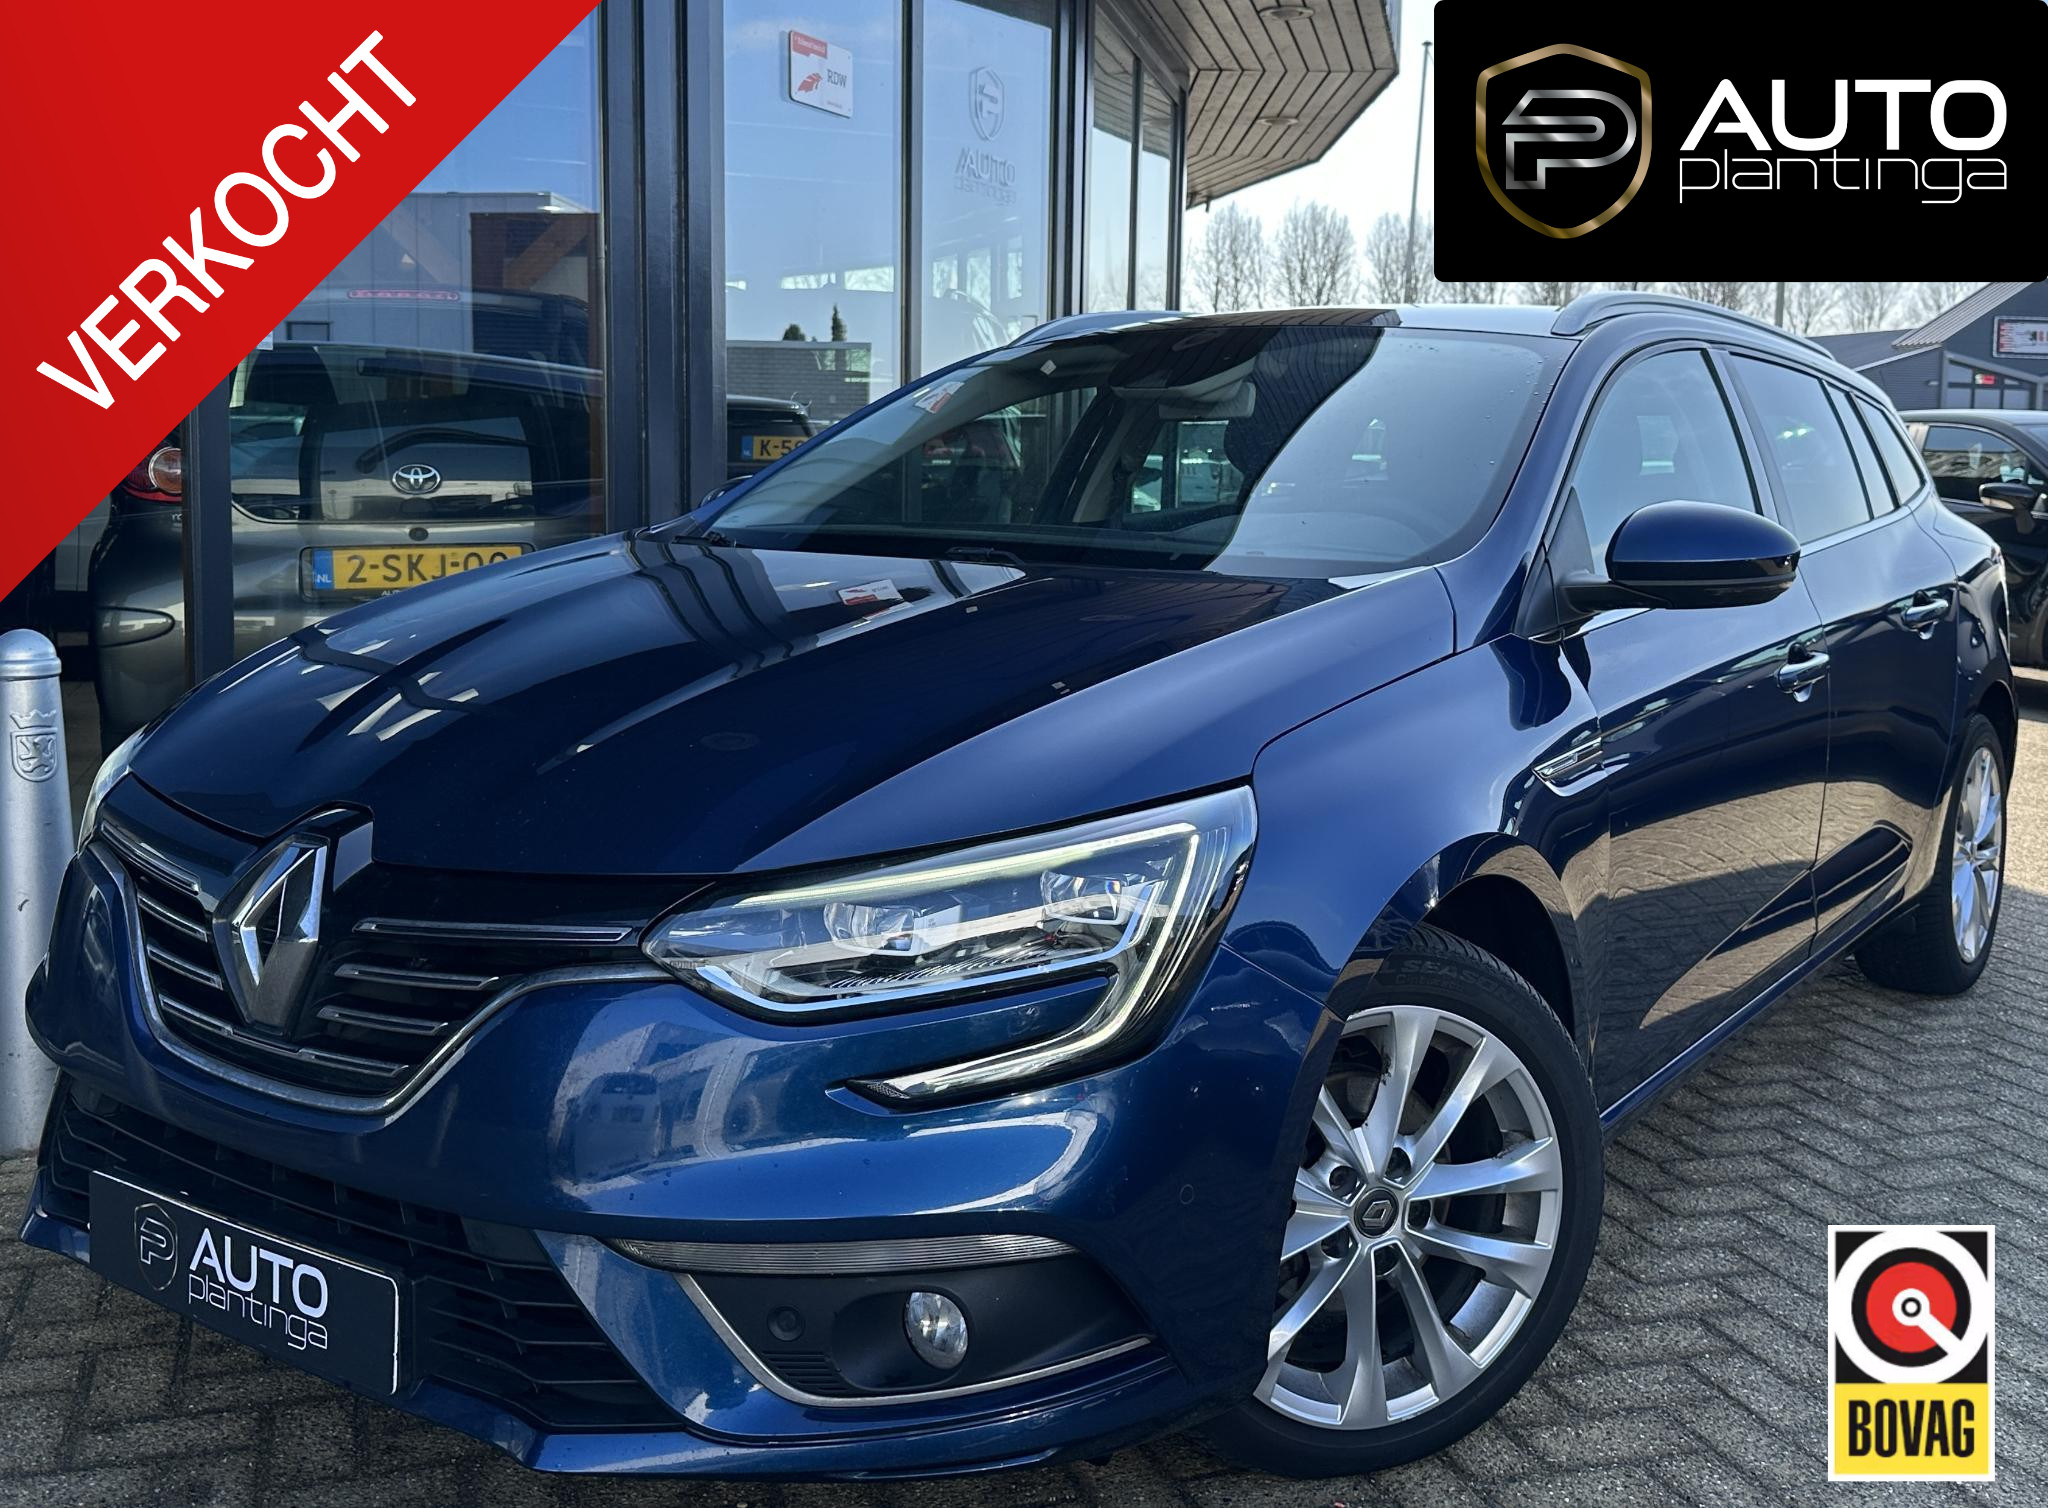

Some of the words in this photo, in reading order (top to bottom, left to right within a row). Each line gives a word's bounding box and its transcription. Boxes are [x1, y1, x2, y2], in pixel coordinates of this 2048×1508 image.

[826, 68, 848, 88] RDW
[957, 149, 1016, 186] AUTO
[760, 439, 806, 457] K-5
[316, 574, 331, 583] NL
[347, 552, 508, 584] 2-SKJ-0
[189, 1228, 328, 1318] AUTO
[188, 1273, 328, 1350] plantinga
